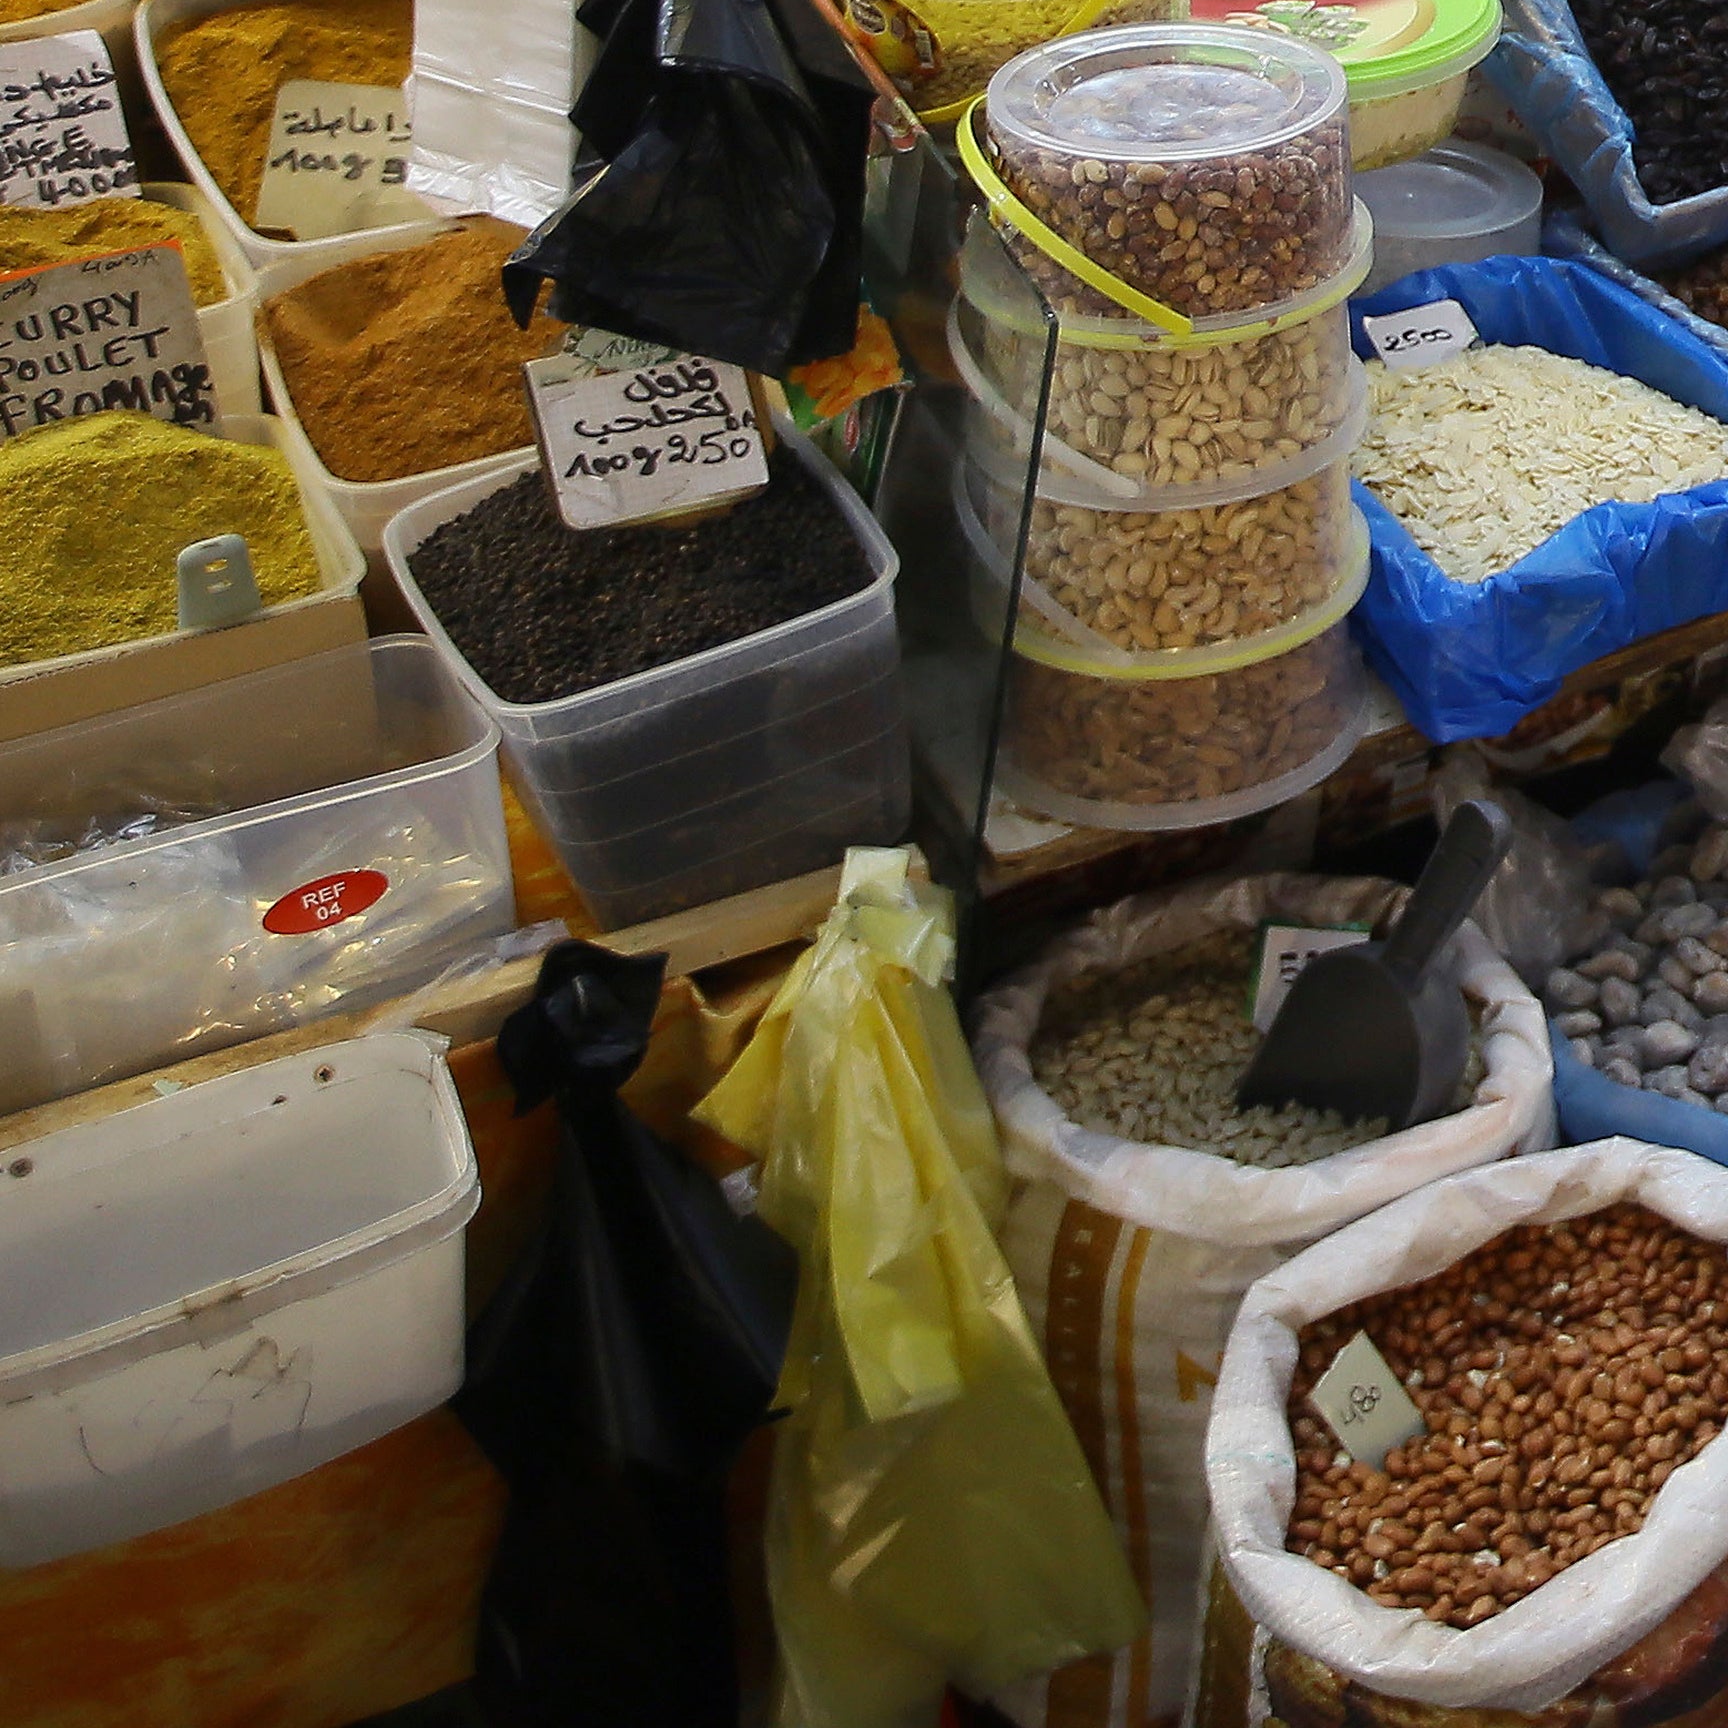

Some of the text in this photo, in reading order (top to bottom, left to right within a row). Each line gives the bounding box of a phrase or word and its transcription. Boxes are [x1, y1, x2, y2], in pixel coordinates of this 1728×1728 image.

[1383, 328, 1452, 352] 2500
[667, 431, 751, 464] 250
[302, 881, 347, 910] REF
[316, 901, 343, 921] 04
